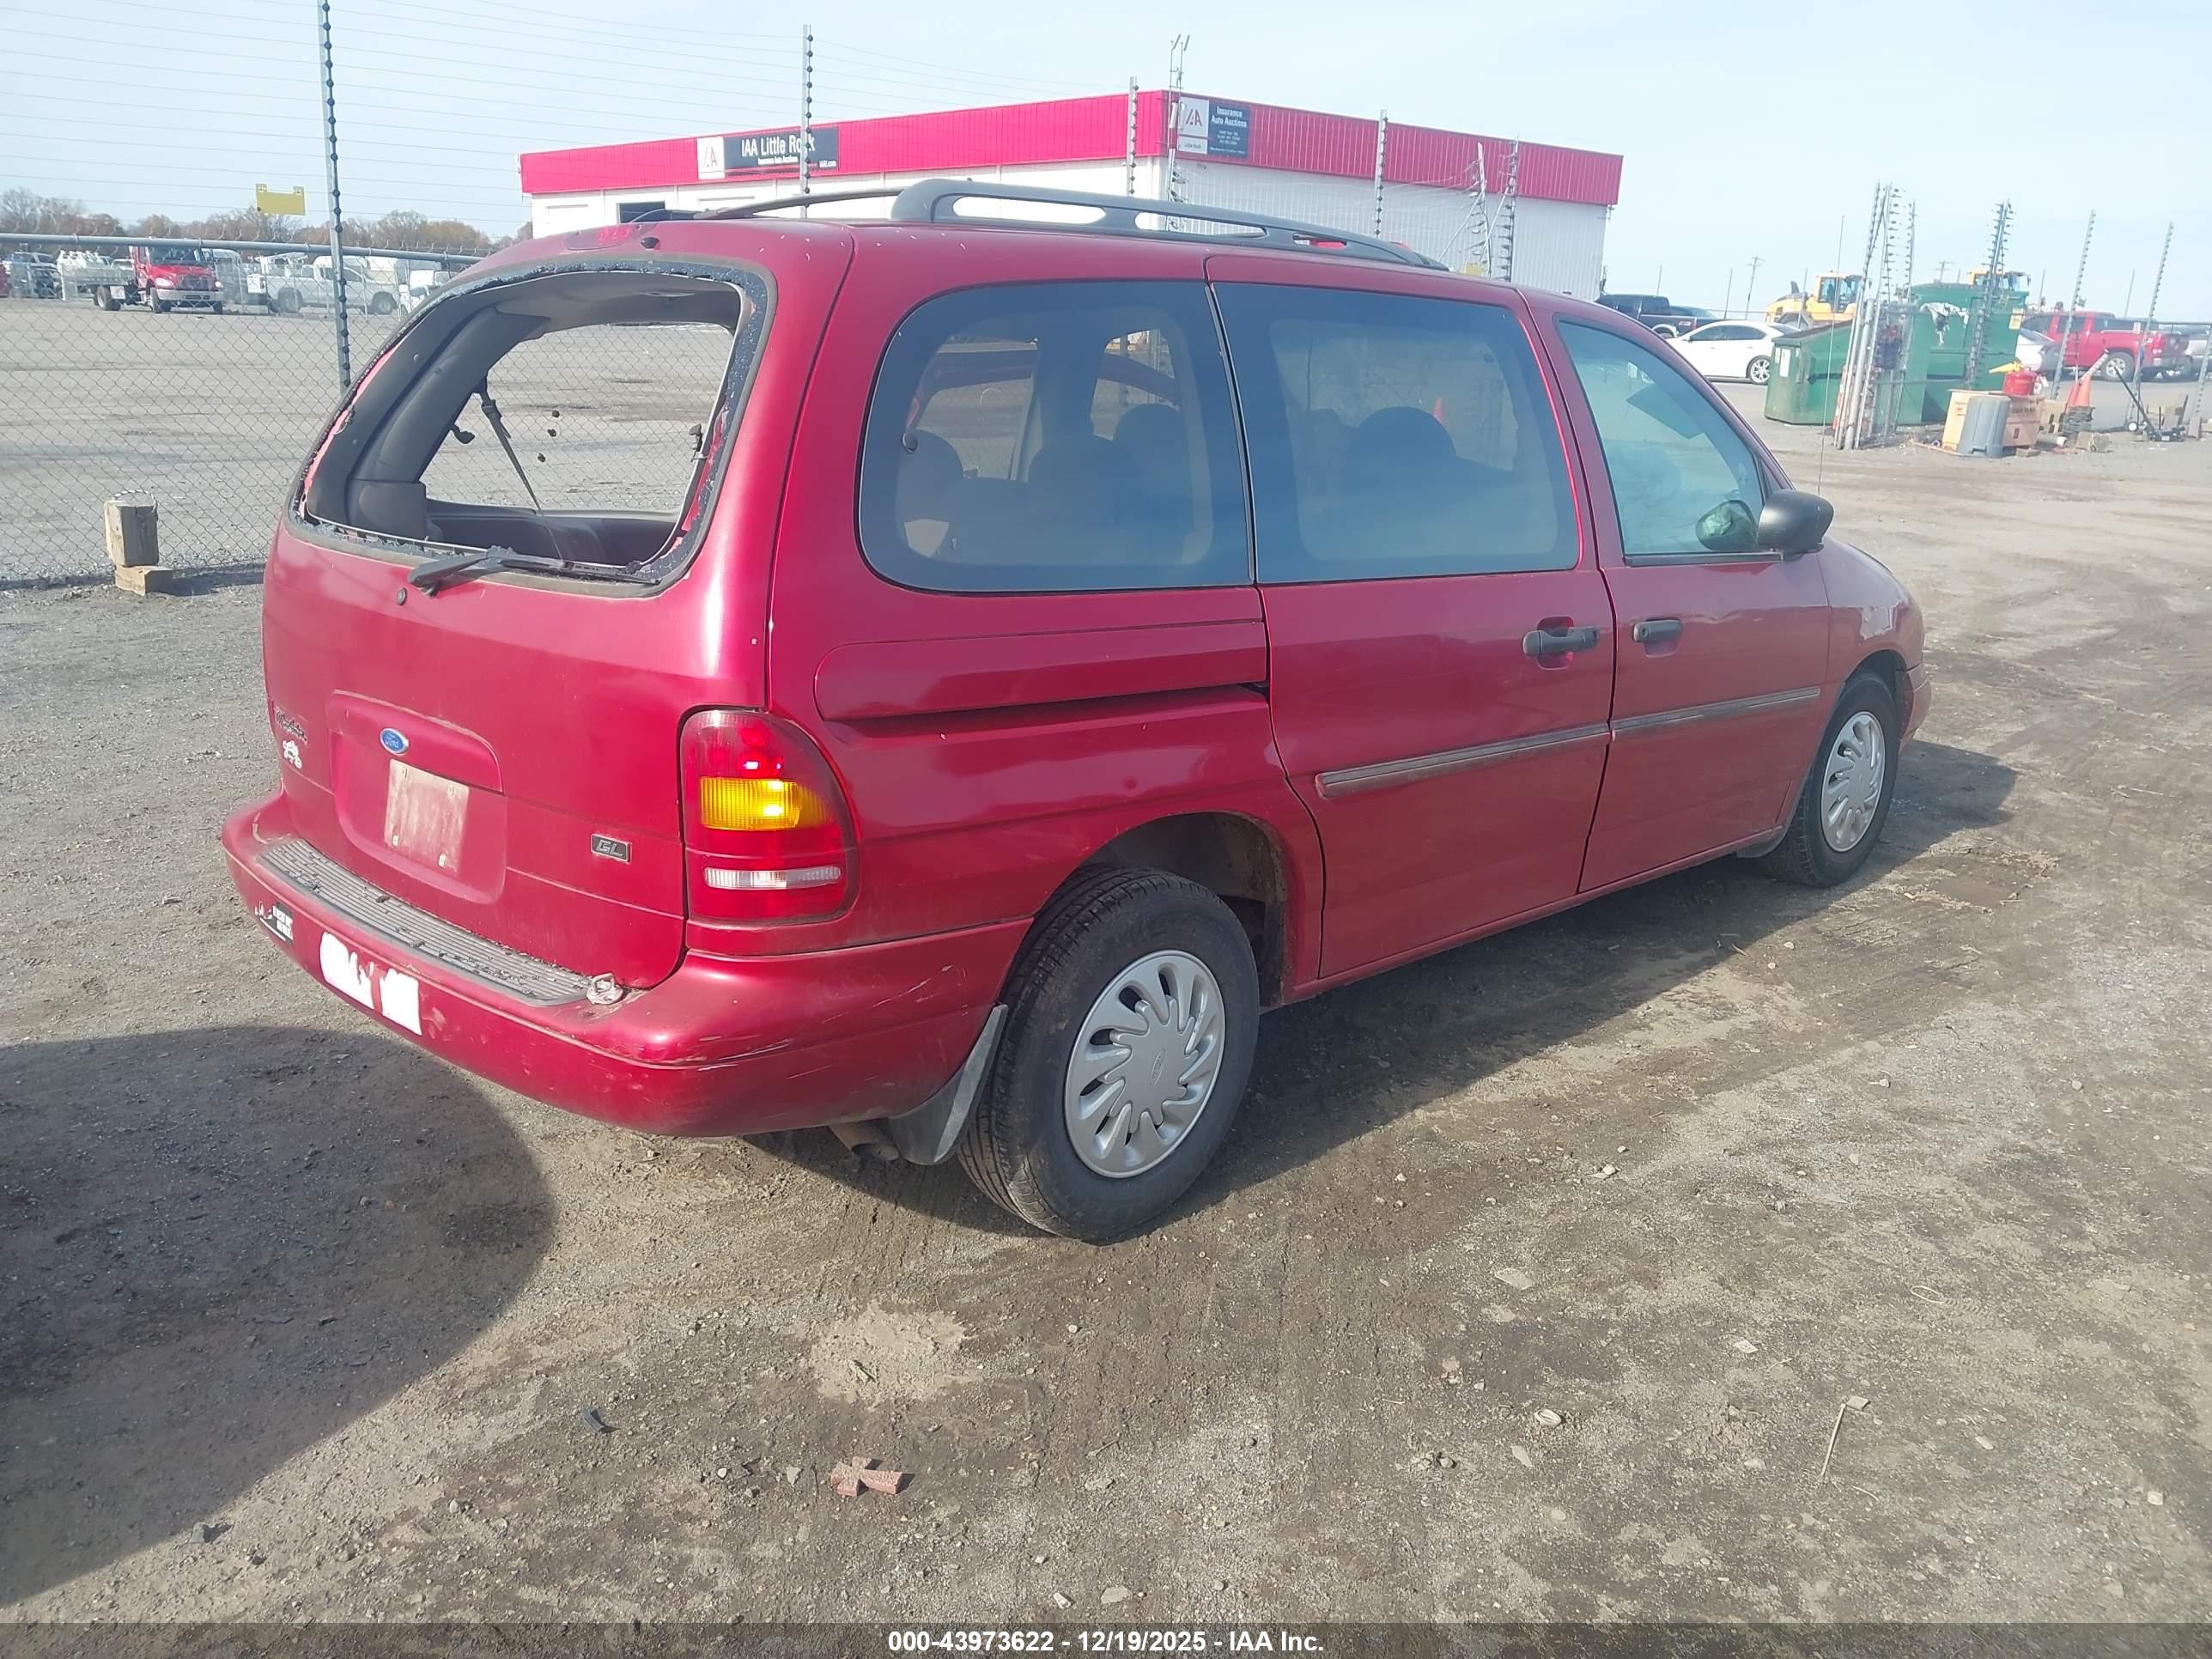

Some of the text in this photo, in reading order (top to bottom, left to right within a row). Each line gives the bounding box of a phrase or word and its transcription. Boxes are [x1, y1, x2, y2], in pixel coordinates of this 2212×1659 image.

[1217, 106, 1243, 118] Insurance
[1211, 115, 1247, 128] Auto Auctions
[742, 133, 815, 157] IAA Little Rok
[596, 839, 623, 857] GL
